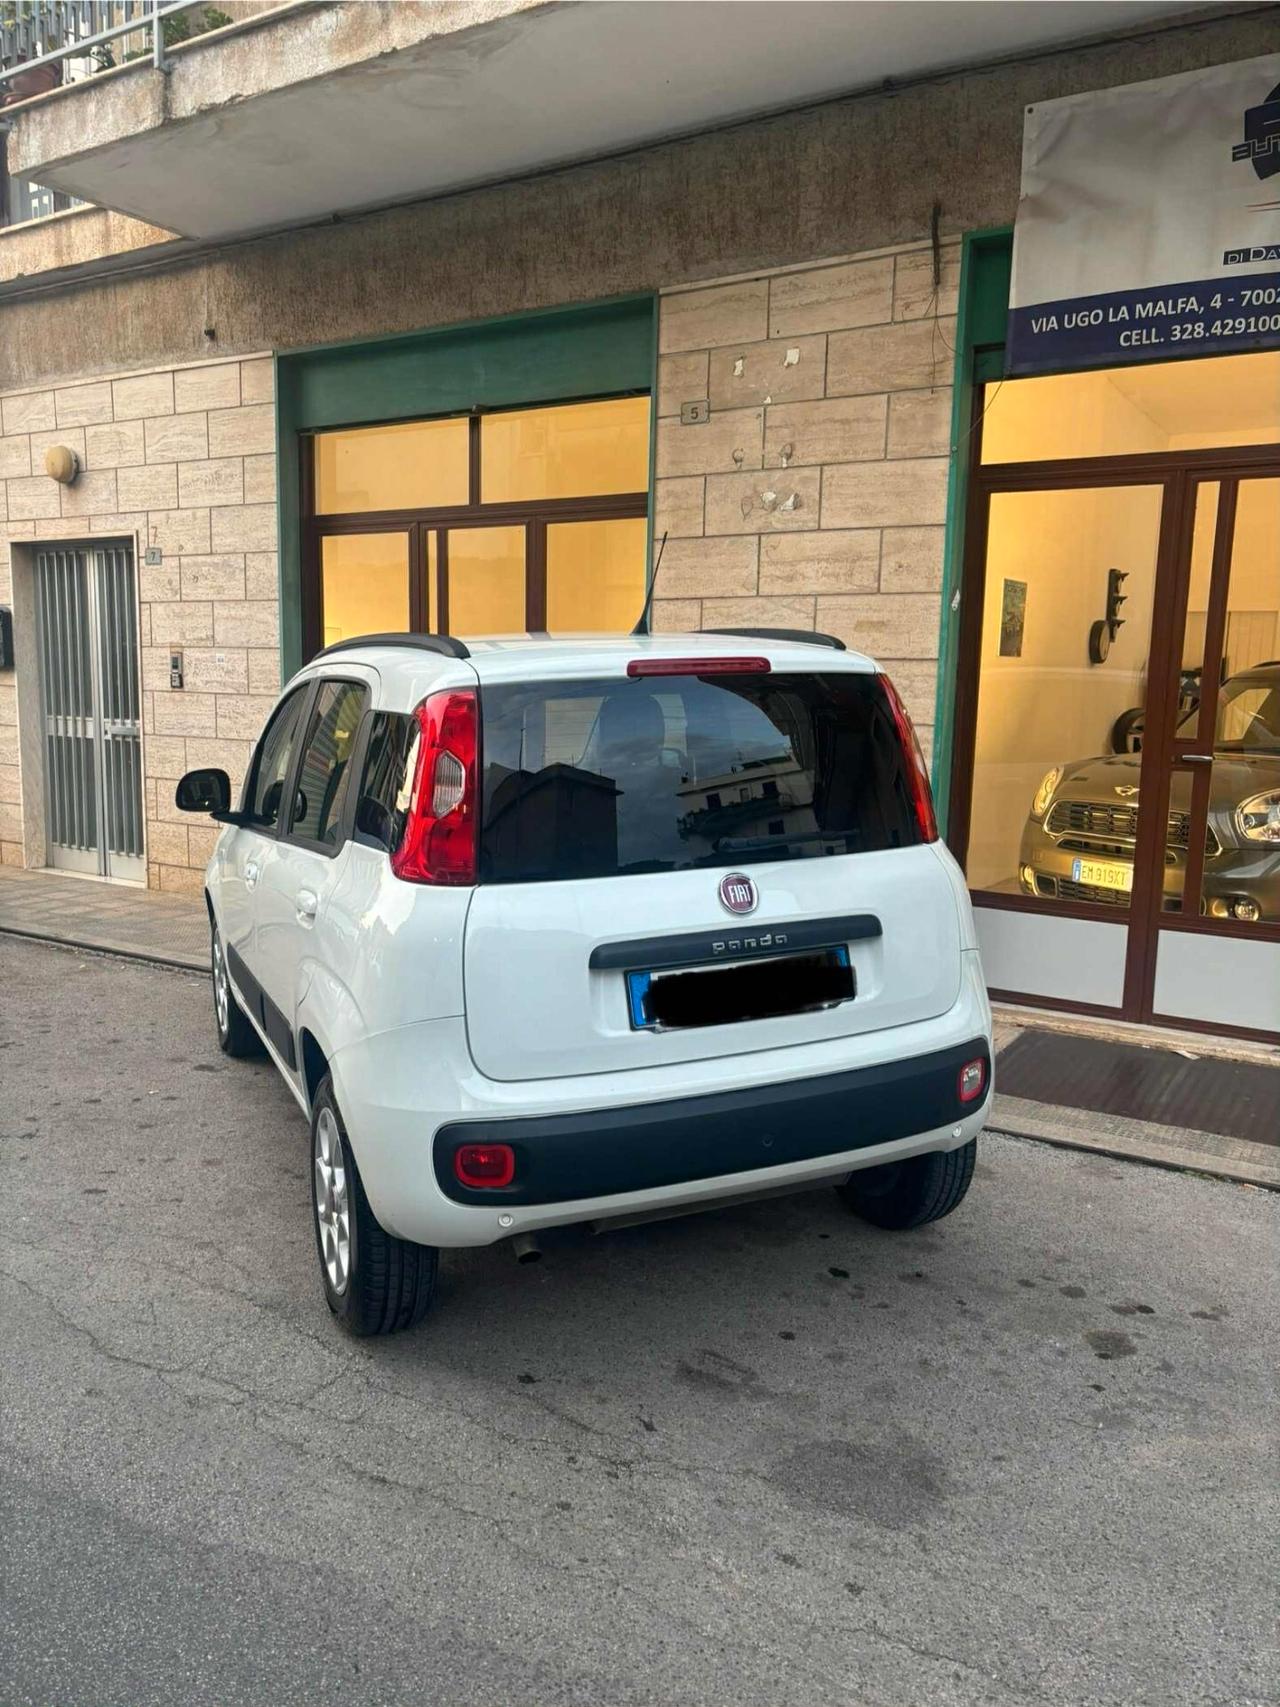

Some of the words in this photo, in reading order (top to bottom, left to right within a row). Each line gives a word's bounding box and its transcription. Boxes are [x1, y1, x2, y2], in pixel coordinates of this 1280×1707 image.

[1227, 252, 1244, 265] DI
[1249, 246, 1280, 262] DA
[1031, 315, 1059, 334] VIA
[1064, 309, 1103, 329] UGO
[1108, 305, 1130, 323] LA
[1135, 295, 1205, 319] MALFA,
[1210, 293, 1222, 309] 4
[1119, 327, 1165, 347] CELL.
[690, 406, 699, 420] 5
[727, 884, 752, 903] FIAT
[712, 933, 788, 954] panda
